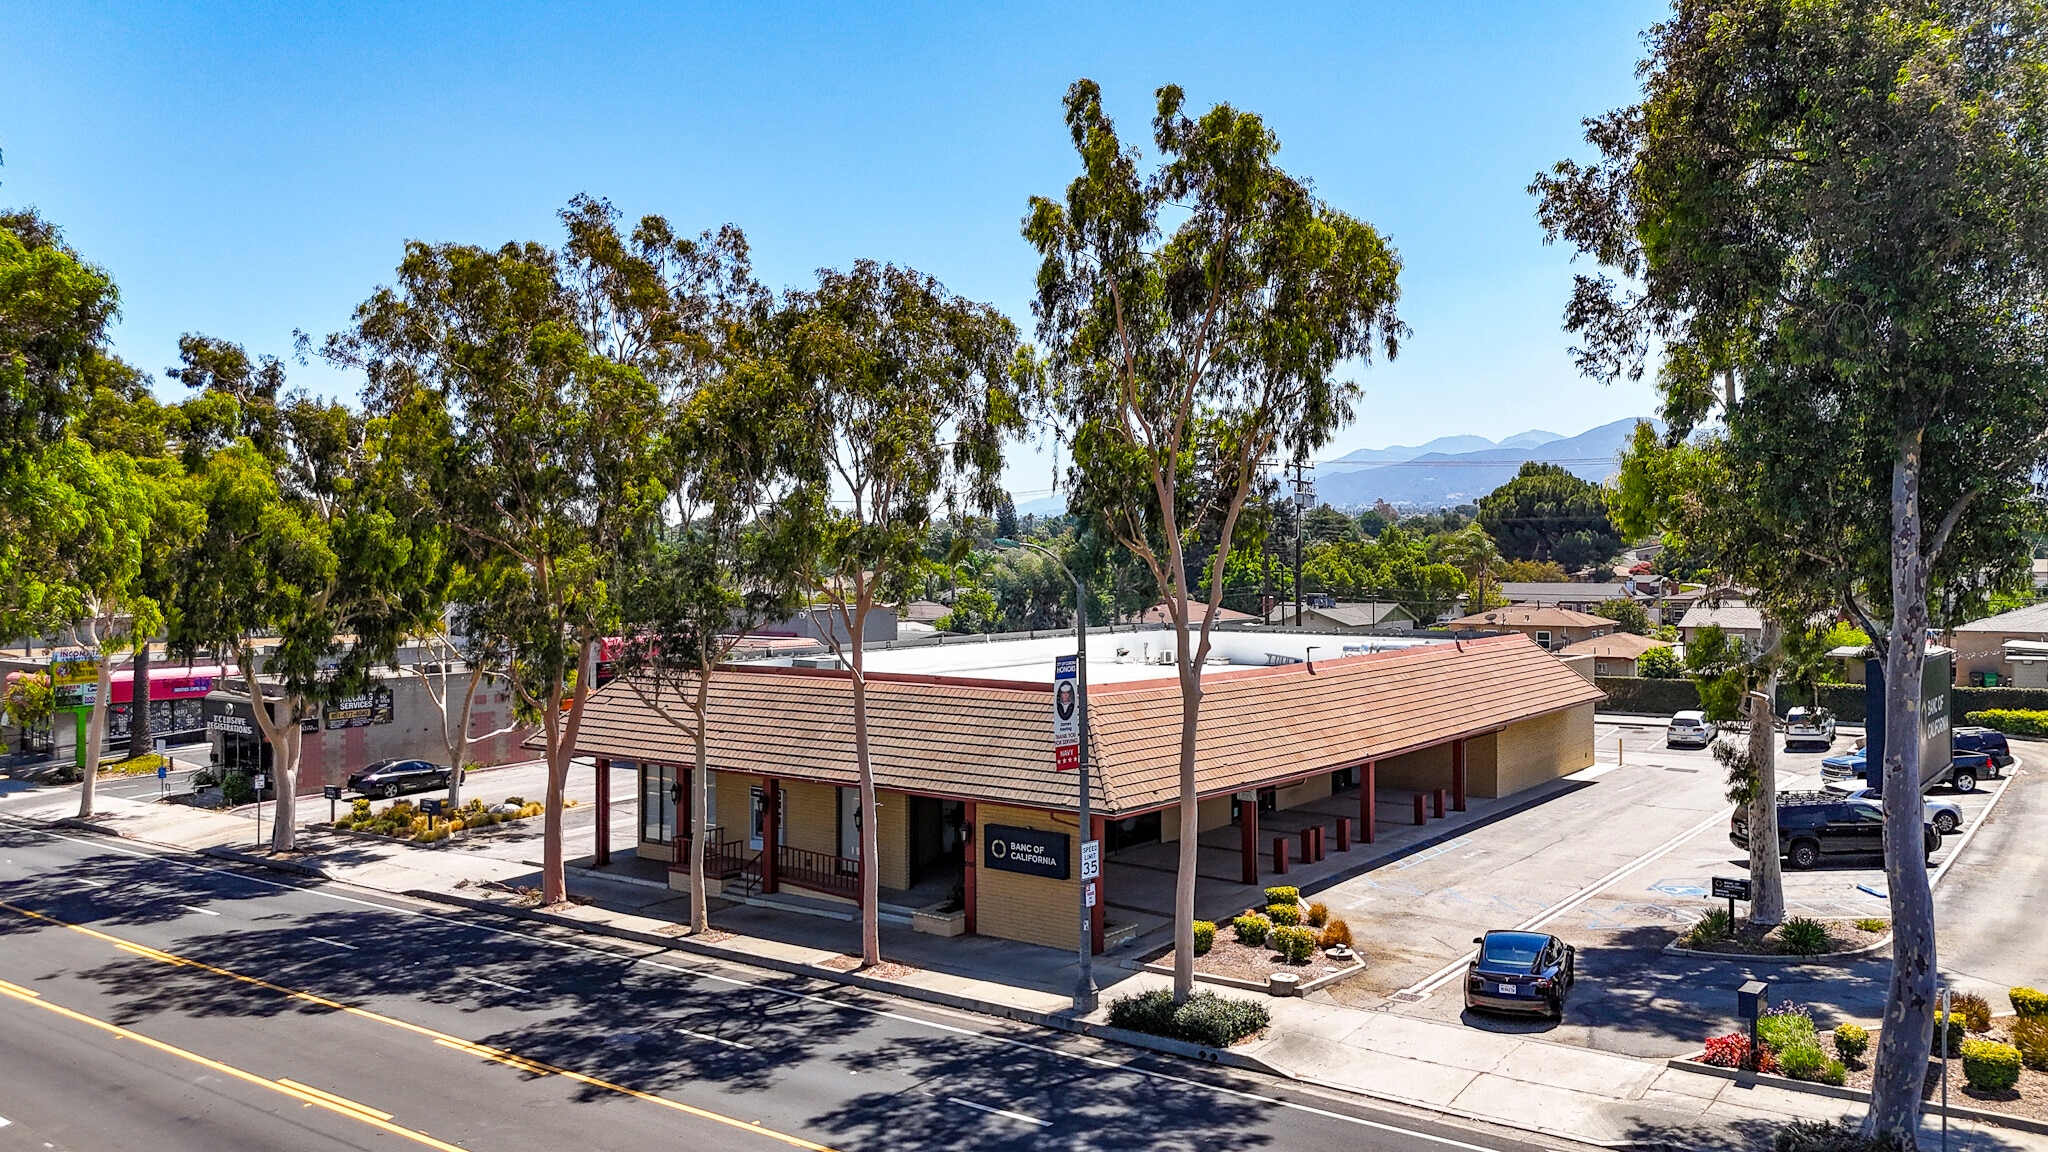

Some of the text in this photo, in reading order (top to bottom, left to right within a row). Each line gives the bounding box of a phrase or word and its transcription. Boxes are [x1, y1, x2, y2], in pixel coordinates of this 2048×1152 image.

[1056, 665, 1076, 673] HONORS
[340, 700, 373, 710] SERVICES
[1927, 694, 1944, 716] BANC OF
[213, 715, 247, 725] XCLUSIVE
[206, 721, 253, 734] REGISTRATIONS
[1927, 714, 1949, 739] CALIFORNIA
[1060, 749, 1074, 757] NAVY
[1010, 842, 1045, 854] BANC OF
[1083, 845, 1097, 853] SPEED
[1010, 852, 1057, 866] CALIFORNIA
[1083, 860, 1098, 875] 35
